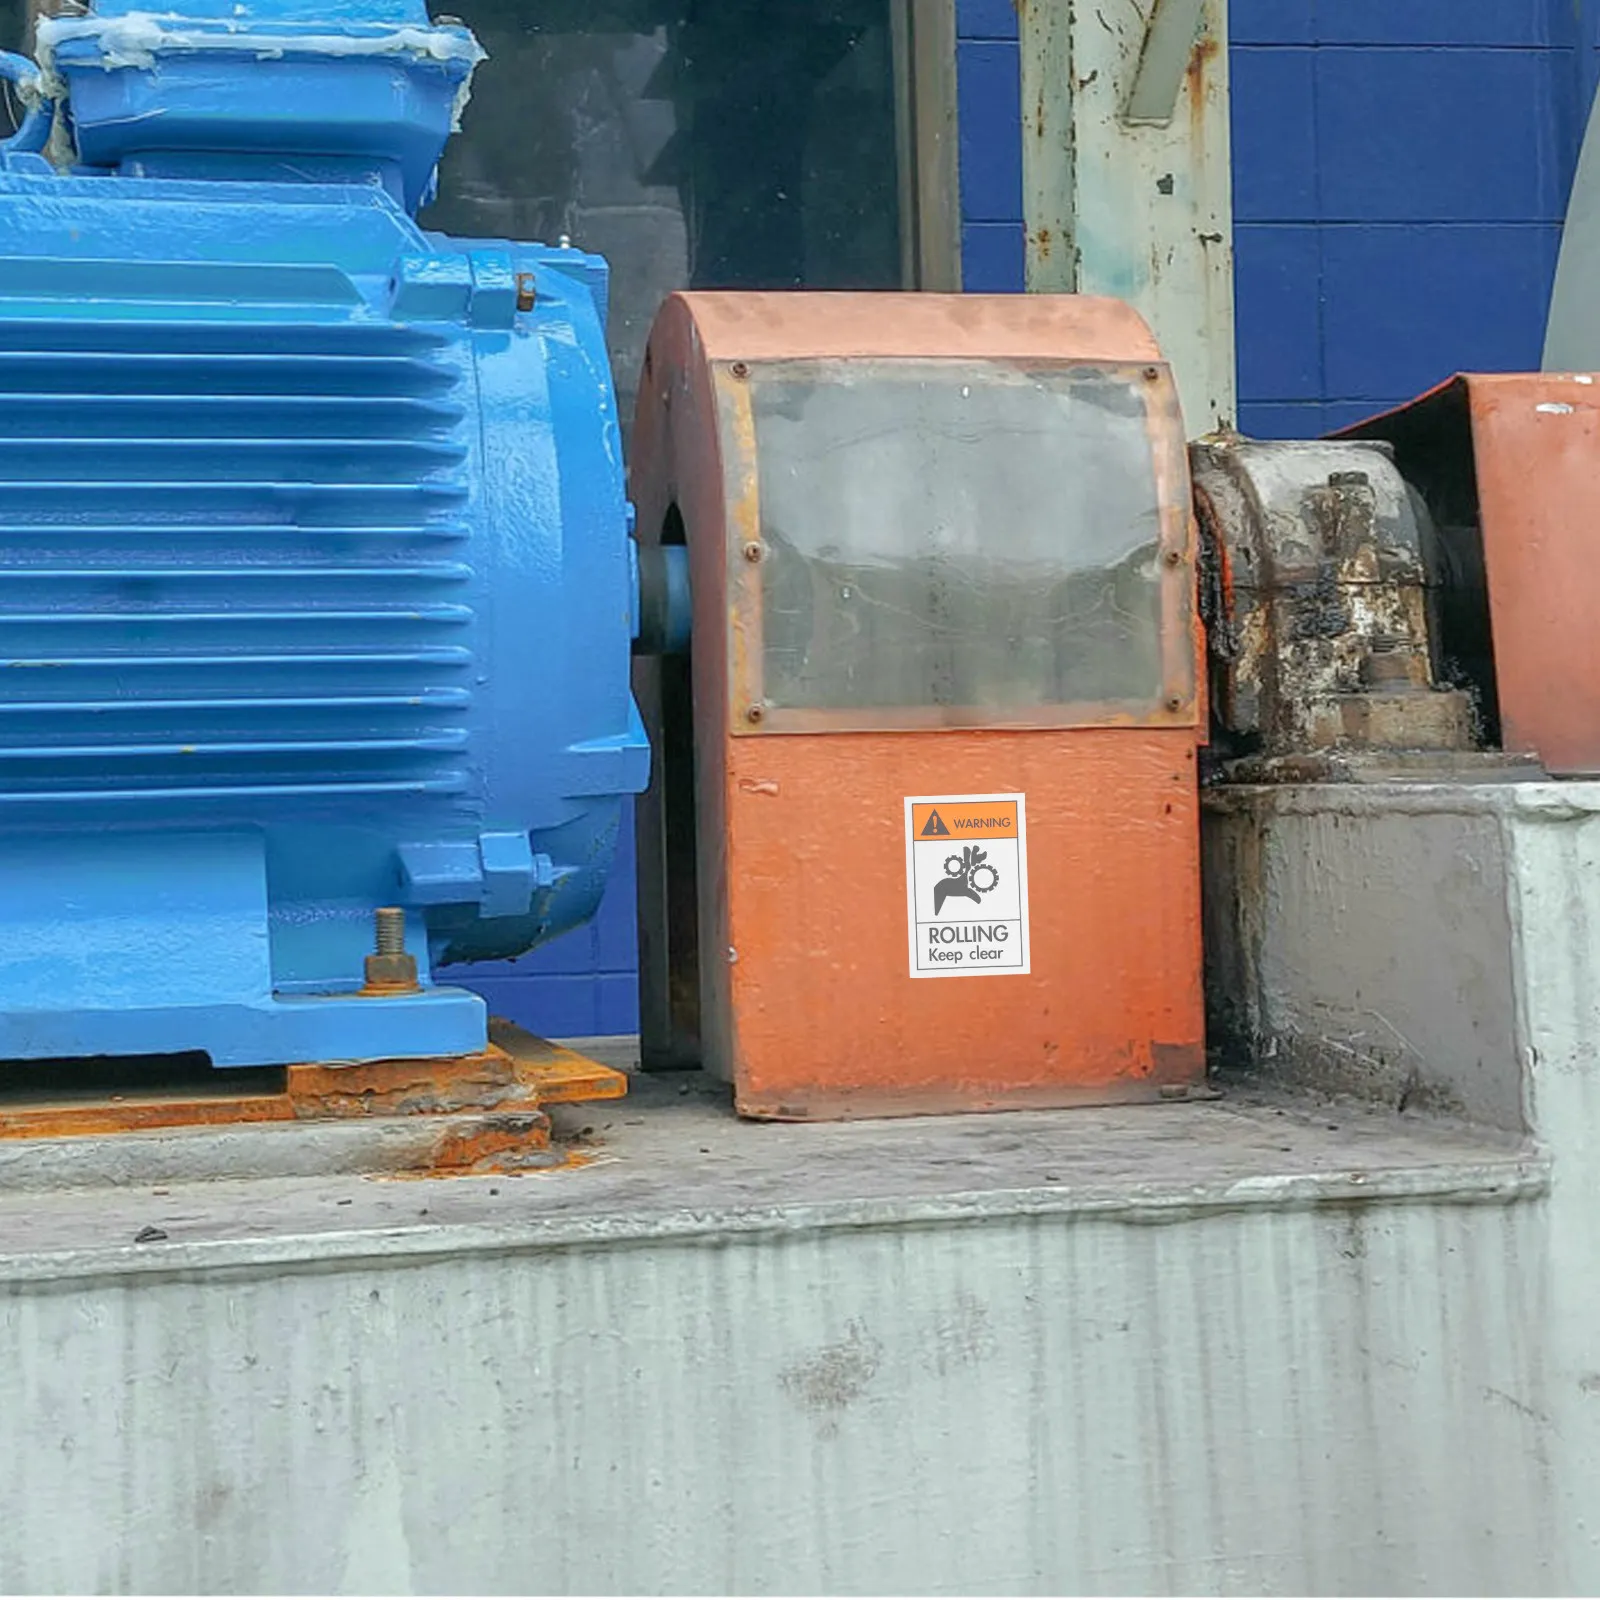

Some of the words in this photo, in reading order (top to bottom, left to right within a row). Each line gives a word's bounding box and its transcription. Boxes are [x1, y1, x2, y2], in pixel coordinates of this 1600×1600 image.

[953, 817, 1011, 829] WARNING
[929, 924, 1008, 944] ROLLING
[929, 948, 963, 964] Keep
[969, 945, 1004, 960] clear
